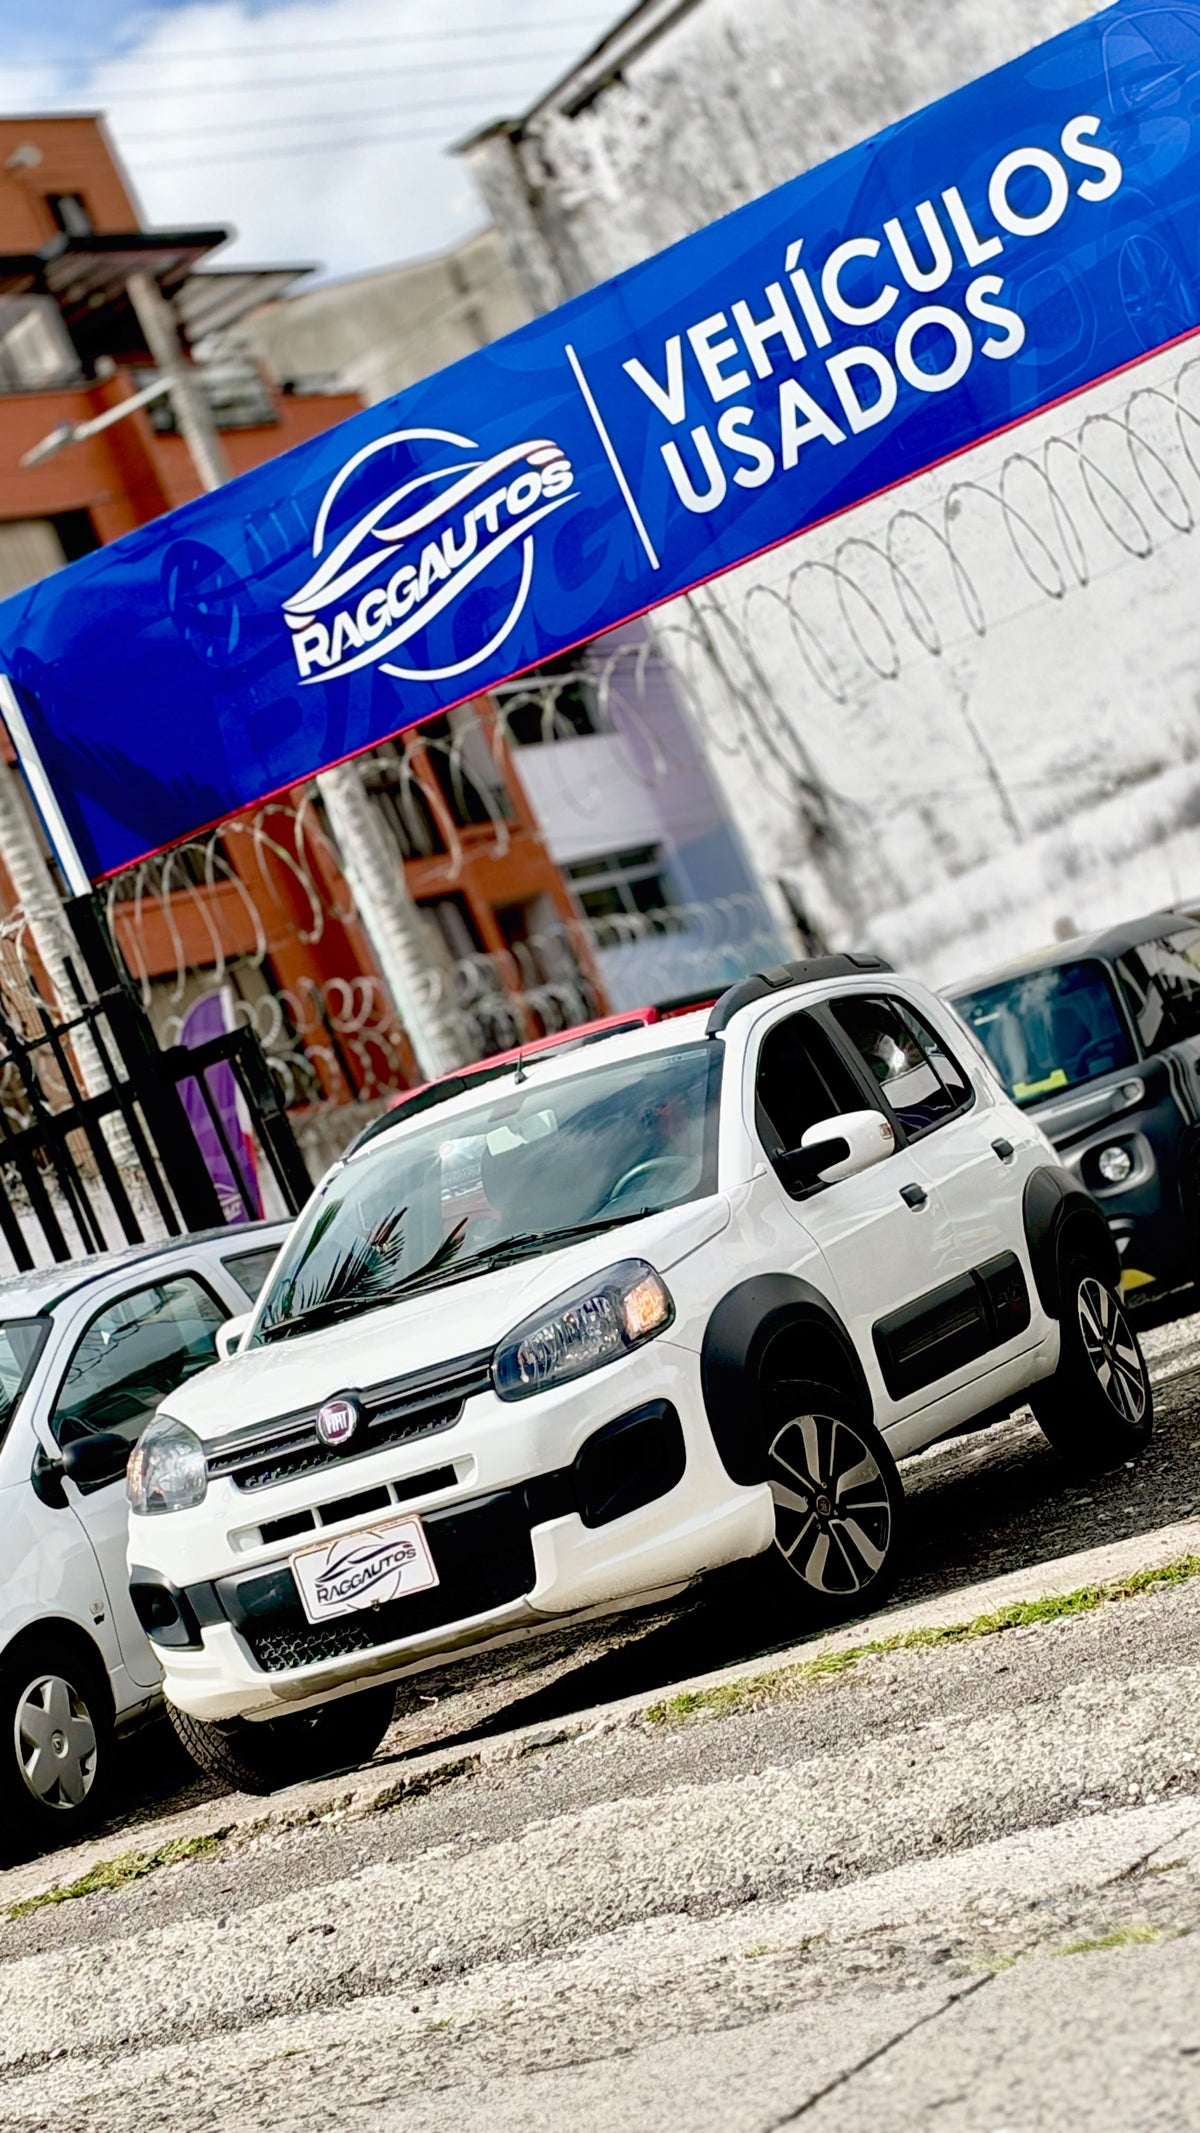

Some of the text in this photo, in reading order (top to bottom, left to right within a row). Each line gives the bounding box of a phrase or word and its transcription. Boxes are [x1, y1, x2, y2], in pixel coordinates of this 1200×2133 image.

[623, 115, 1122, 425] VEHÍCULOS
[660, 275, 1025, 513] USADOS
[292, 461, 574, 677] RAGGAUTOS
[325, 1410, 348, 1434] FIAT
[316, 1547, 416, 1604] RAGGAUTOS
